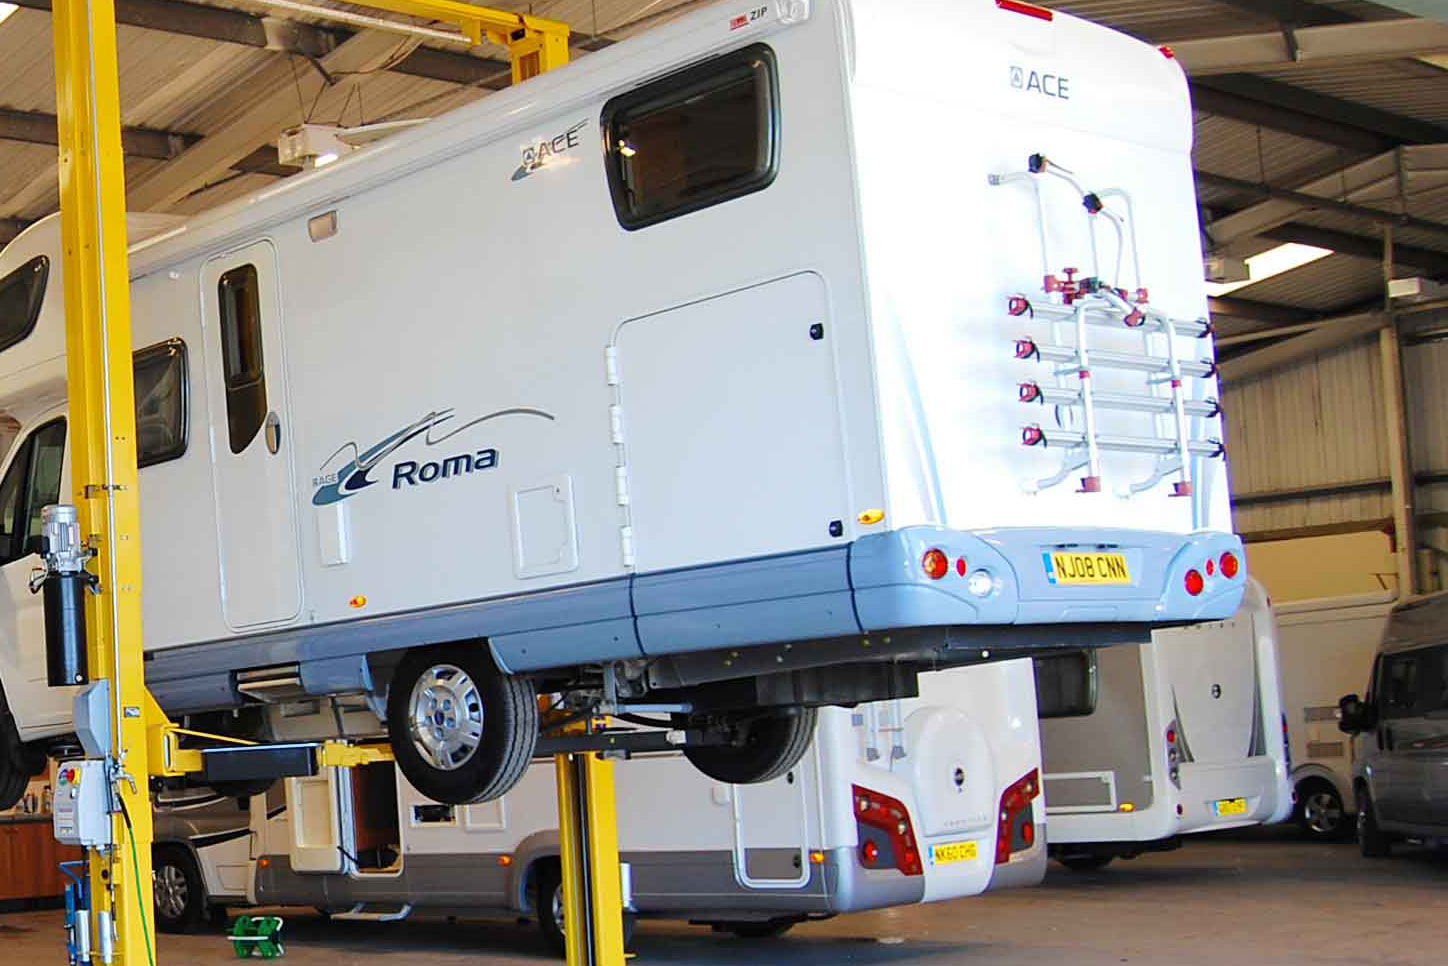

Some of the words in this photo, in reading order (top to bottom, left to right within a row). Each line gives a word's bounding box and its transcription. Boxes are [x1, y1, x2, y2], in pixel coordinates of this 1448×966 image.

[1026, 70, 1070, 99] ACE
[392, 448, 499, 490] Roma
[1055, 556, 1095, 578] NJ08
[1096, 556, 1127, 578] CNN
